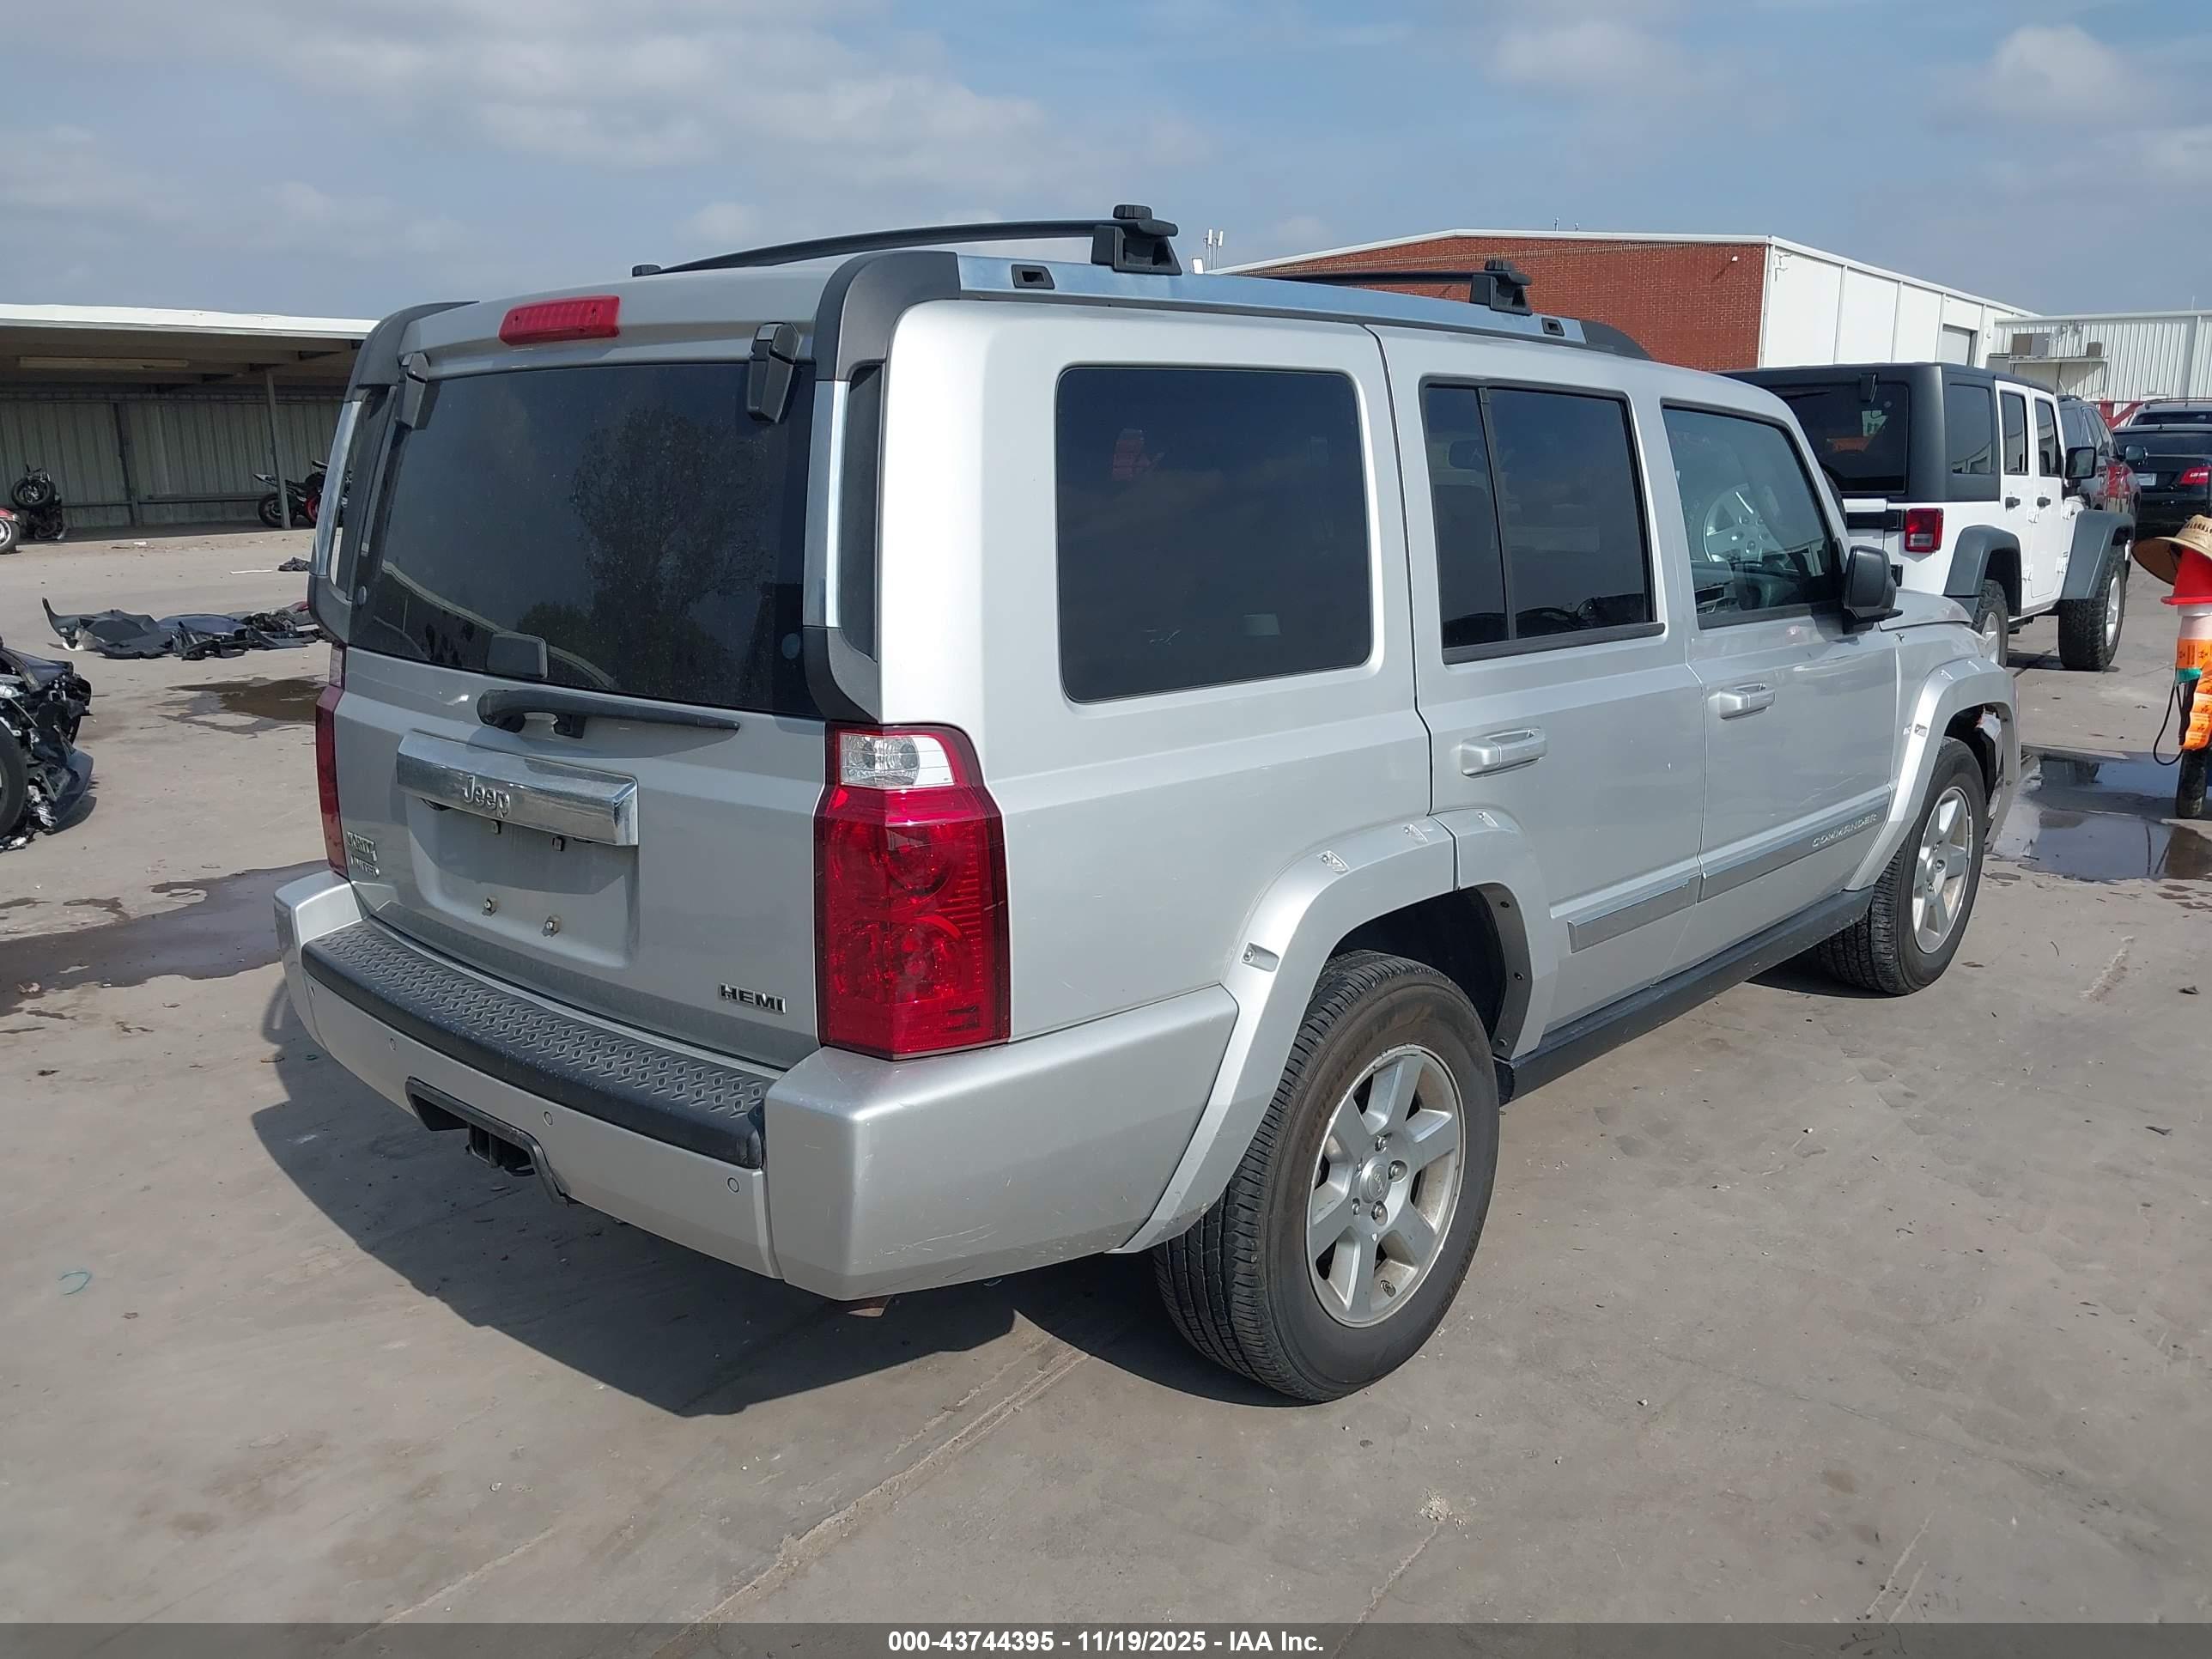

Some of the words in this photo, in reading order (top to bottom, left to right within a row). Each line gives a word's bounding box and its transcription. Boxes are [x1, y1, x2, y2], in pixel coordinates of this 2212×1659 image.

[462, 775, 510, 818] Jeep
[1813, 813, 1877, 848] COMMANDER
[720, 982, 787, 1014] HEMI
